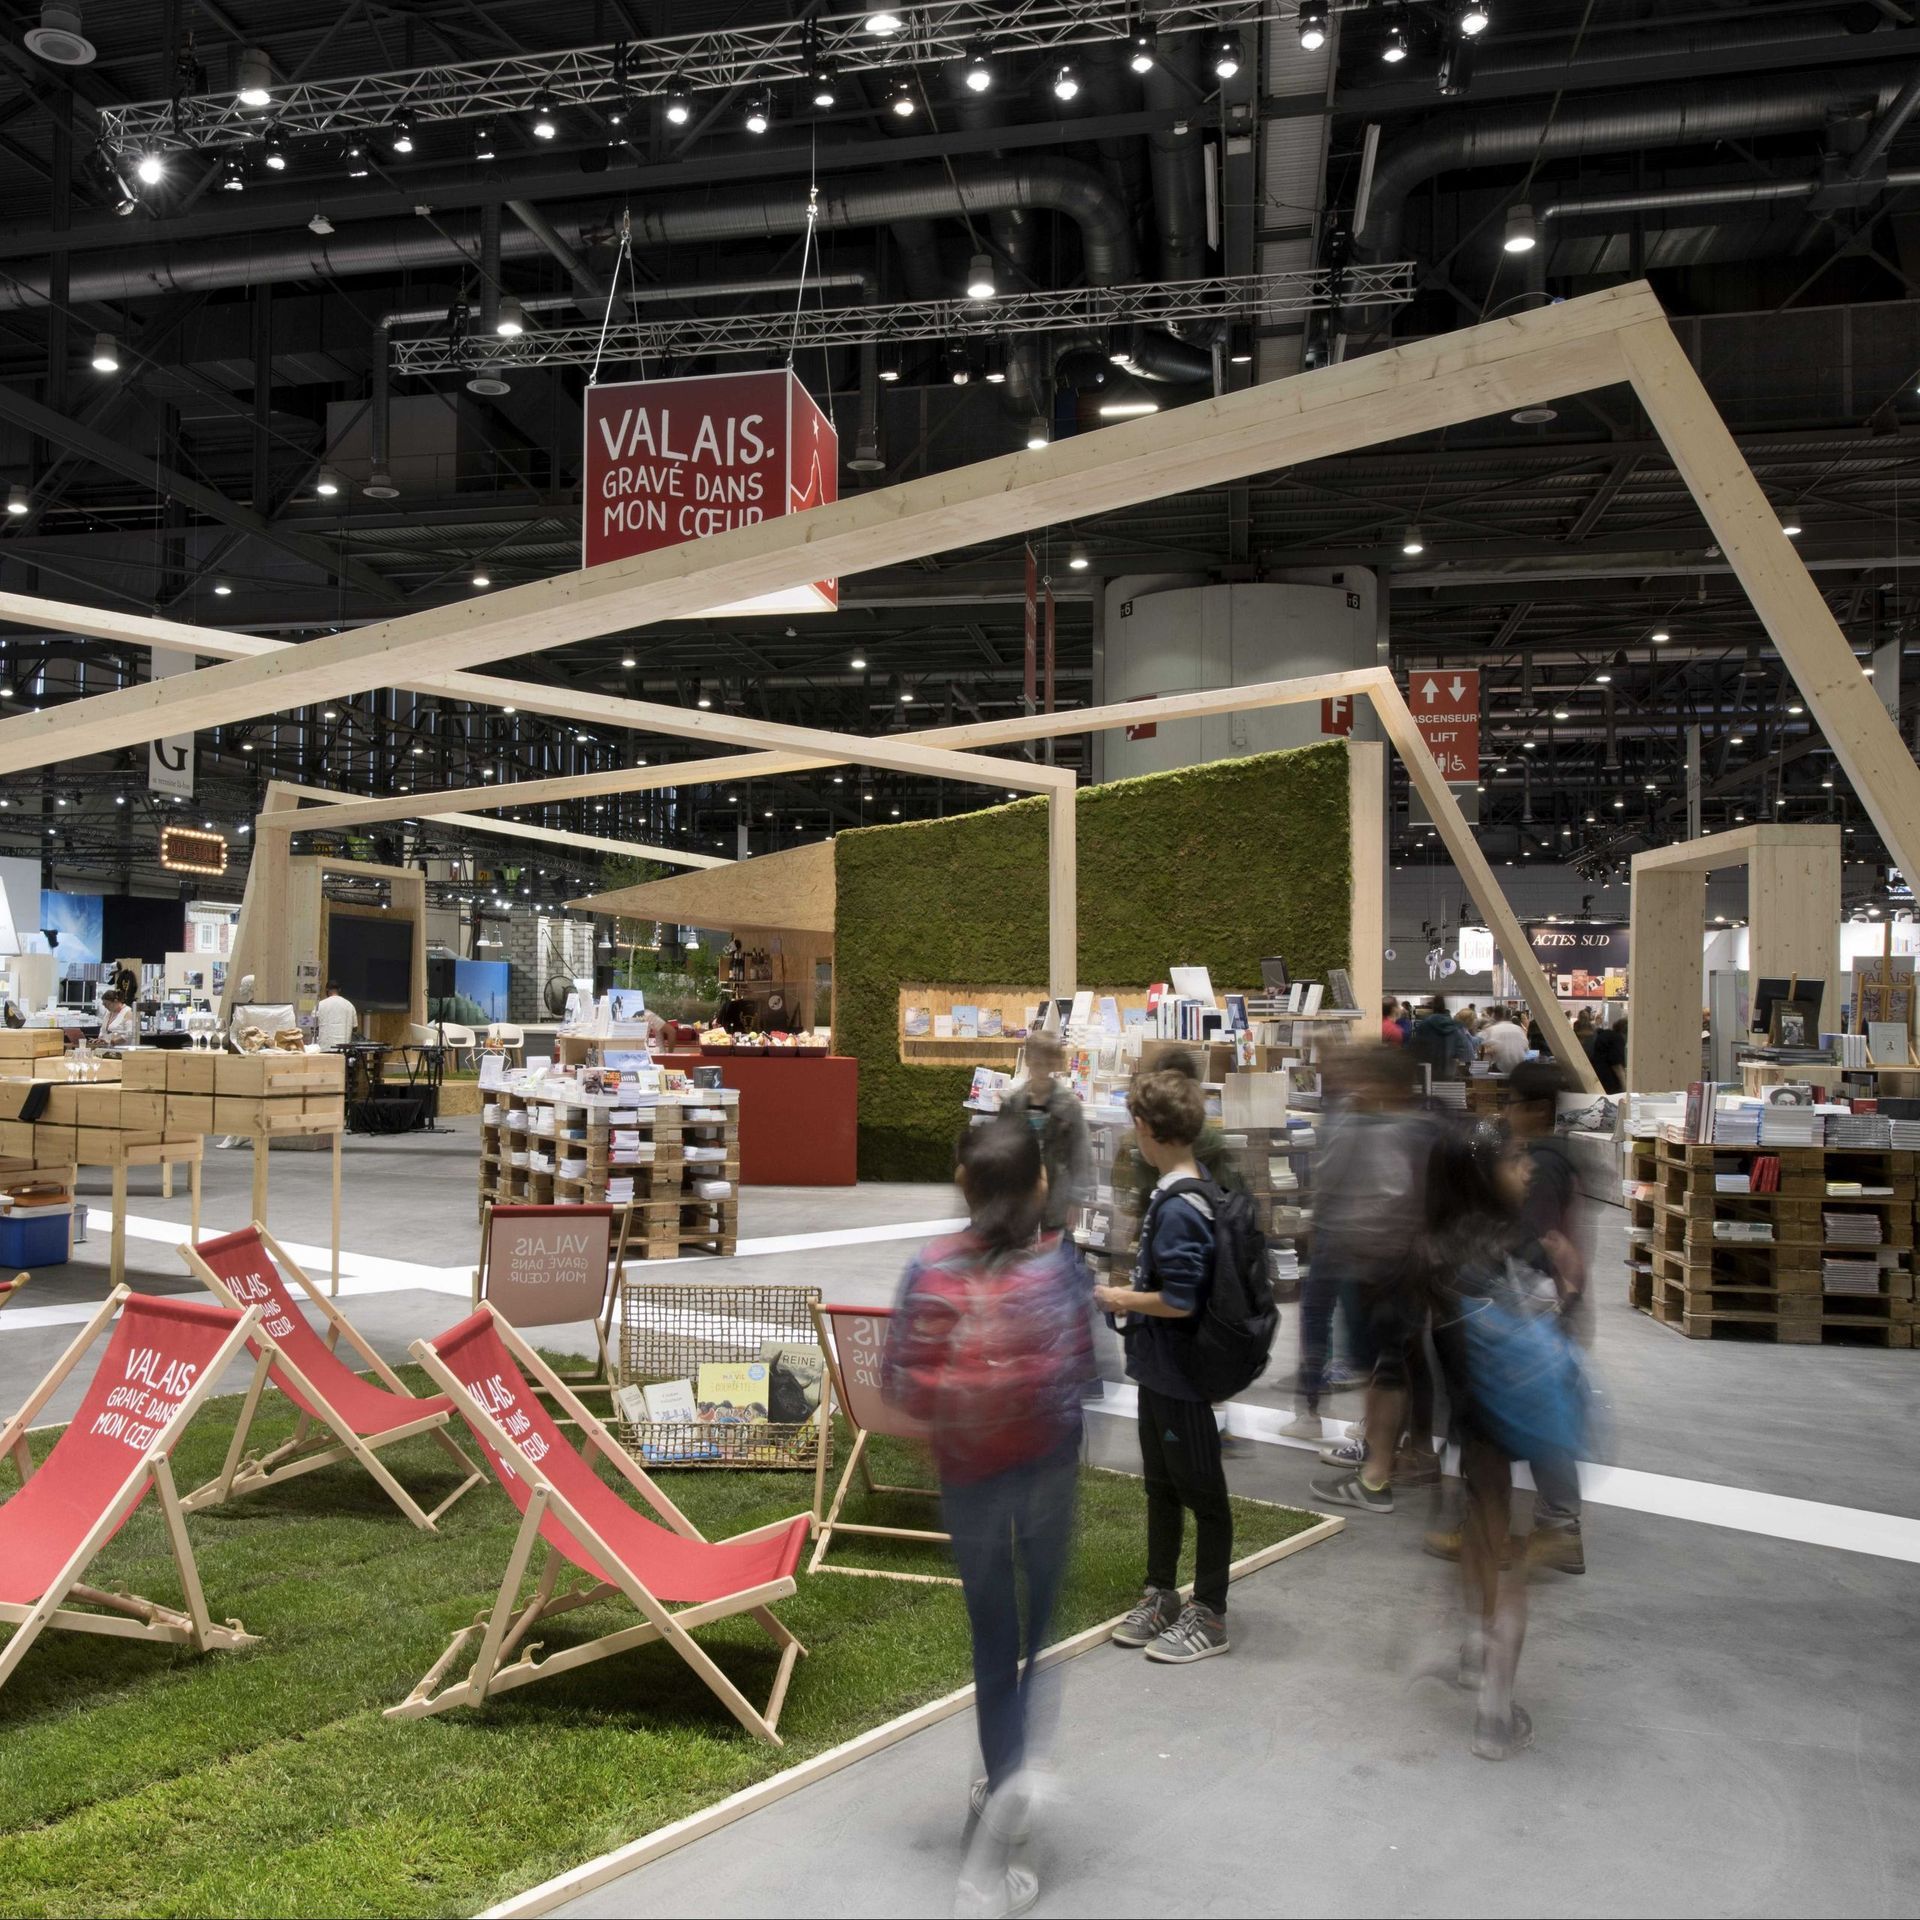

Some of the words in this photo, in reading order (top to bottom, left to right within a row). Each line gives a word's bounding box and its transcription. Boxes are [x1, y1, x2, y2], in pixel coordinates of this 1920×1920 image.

[599, 406, 775, 467] VALAIS.
[602, 461, 685, 499] GRAVÉ
[695, 471, 764, 504] DANS
[603, 499, 667, 537] MON
[1331, 696, 1347, 724] F
[1412, 714, 1478, 723] ASCENSEUR
[1430, 732, 1458, 742] LIFT
[1532, 935, 1577, 946] ACTES
[1580, 935, 1610, 946] SUD
[782, 1354, 817, 1367] REINE
[106, 1386, 152, 1415] GRAVÉ
[144, 1397, 181, 1424] DANS
[90, 1411, 130, 1440] MON
[123, 1421, 160, 1450] CŒU
[505, 1408, 531, 1437] DANS
[517, 1432, 550, 1462] ŒUR.
